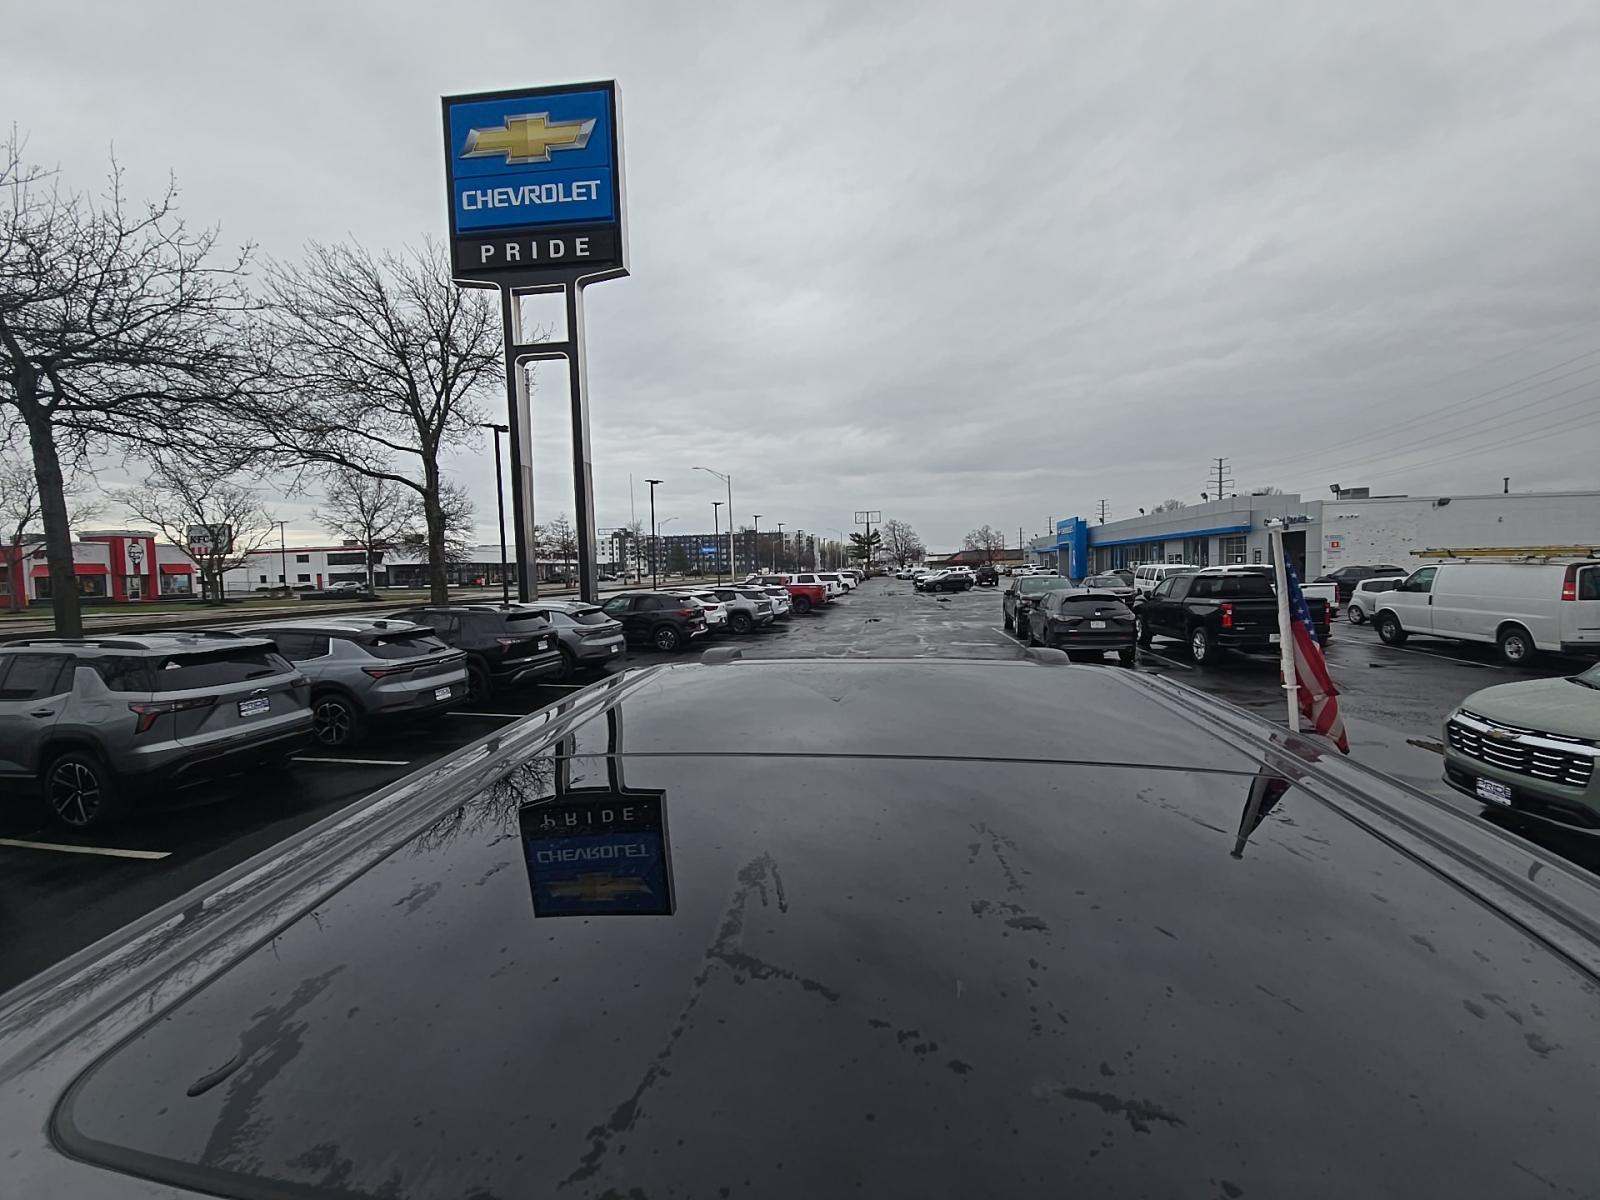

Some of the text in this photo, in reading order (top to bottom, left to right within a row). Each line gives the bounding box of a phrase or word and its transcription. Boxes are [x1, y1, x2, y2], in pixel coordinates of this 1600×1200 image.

[462, 180, 601, 211] CHEVROLET
[480, 237, 590, 264] PRIDE
[190, 536, 210, 544] KFC
